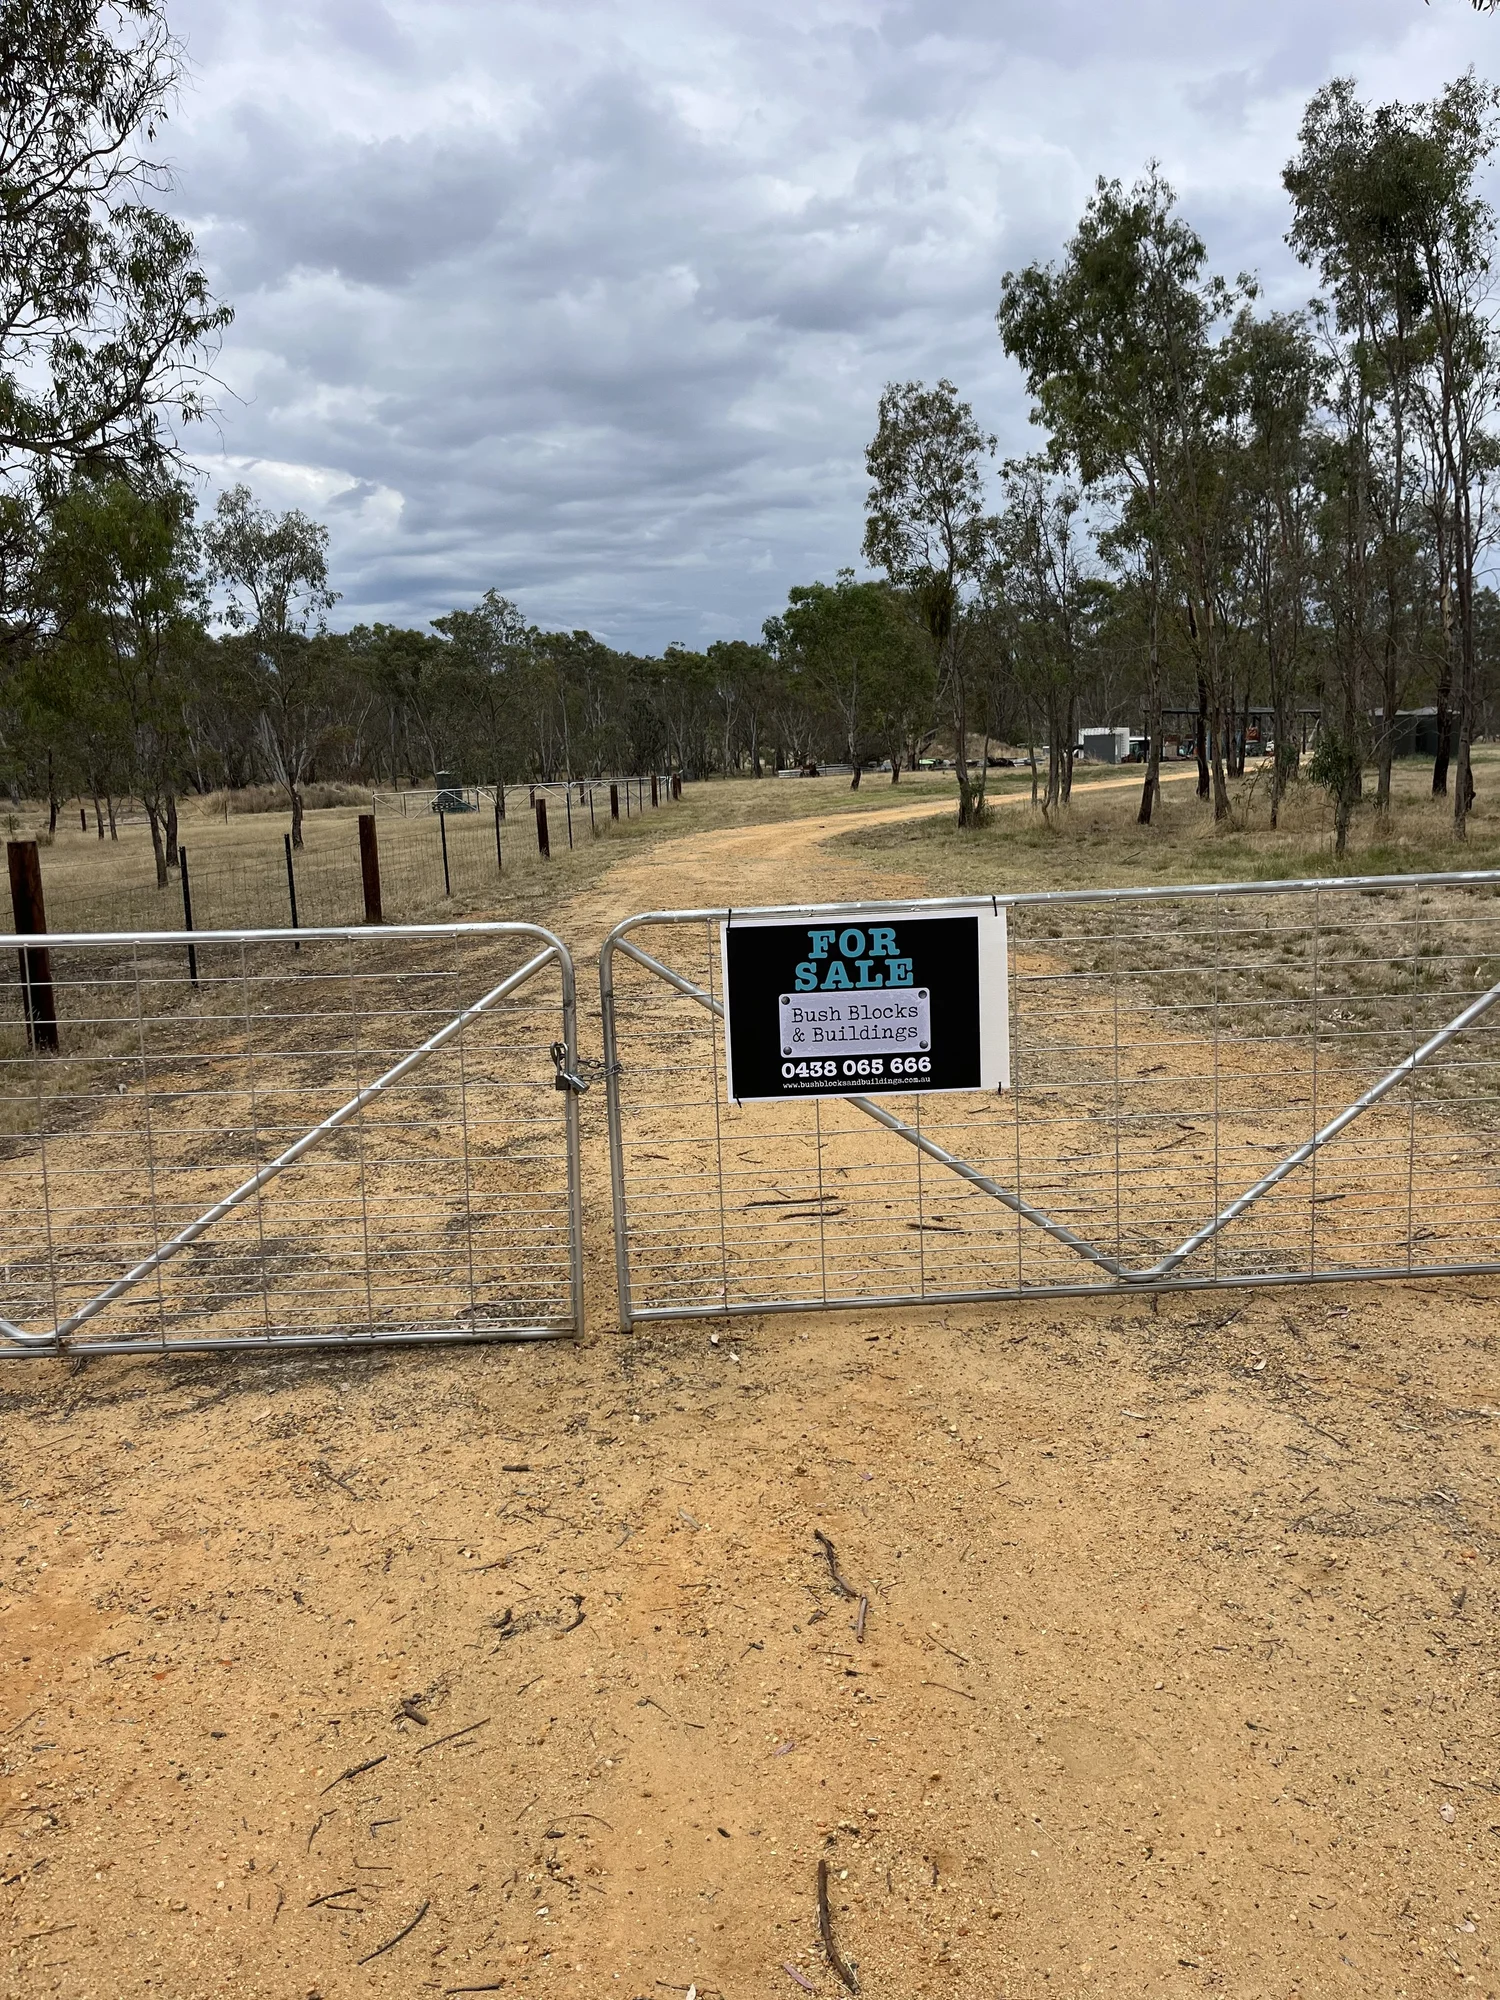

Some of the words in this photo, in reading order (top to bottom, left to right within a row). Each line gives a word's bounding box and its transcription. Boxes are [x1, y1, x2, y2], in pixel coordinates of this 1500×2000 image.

[807, 927, 900, 959] FOR
[795, 958, 914, 991] SALE
[791, 1006, 842, 1023] Bush
[847, 1004, 919, 1021] Blocks
[792, 1027, 806, 1043] &
[812, 1024, 918, 1043] Buildings
[781, 1060, 837, 1078] 0438
[842, 1058, 884, 1076] 065
[890, 1056, 932, 1073] 666
[783, 1076, 931, 1089] www.bushblocksandbuildings.com.au
